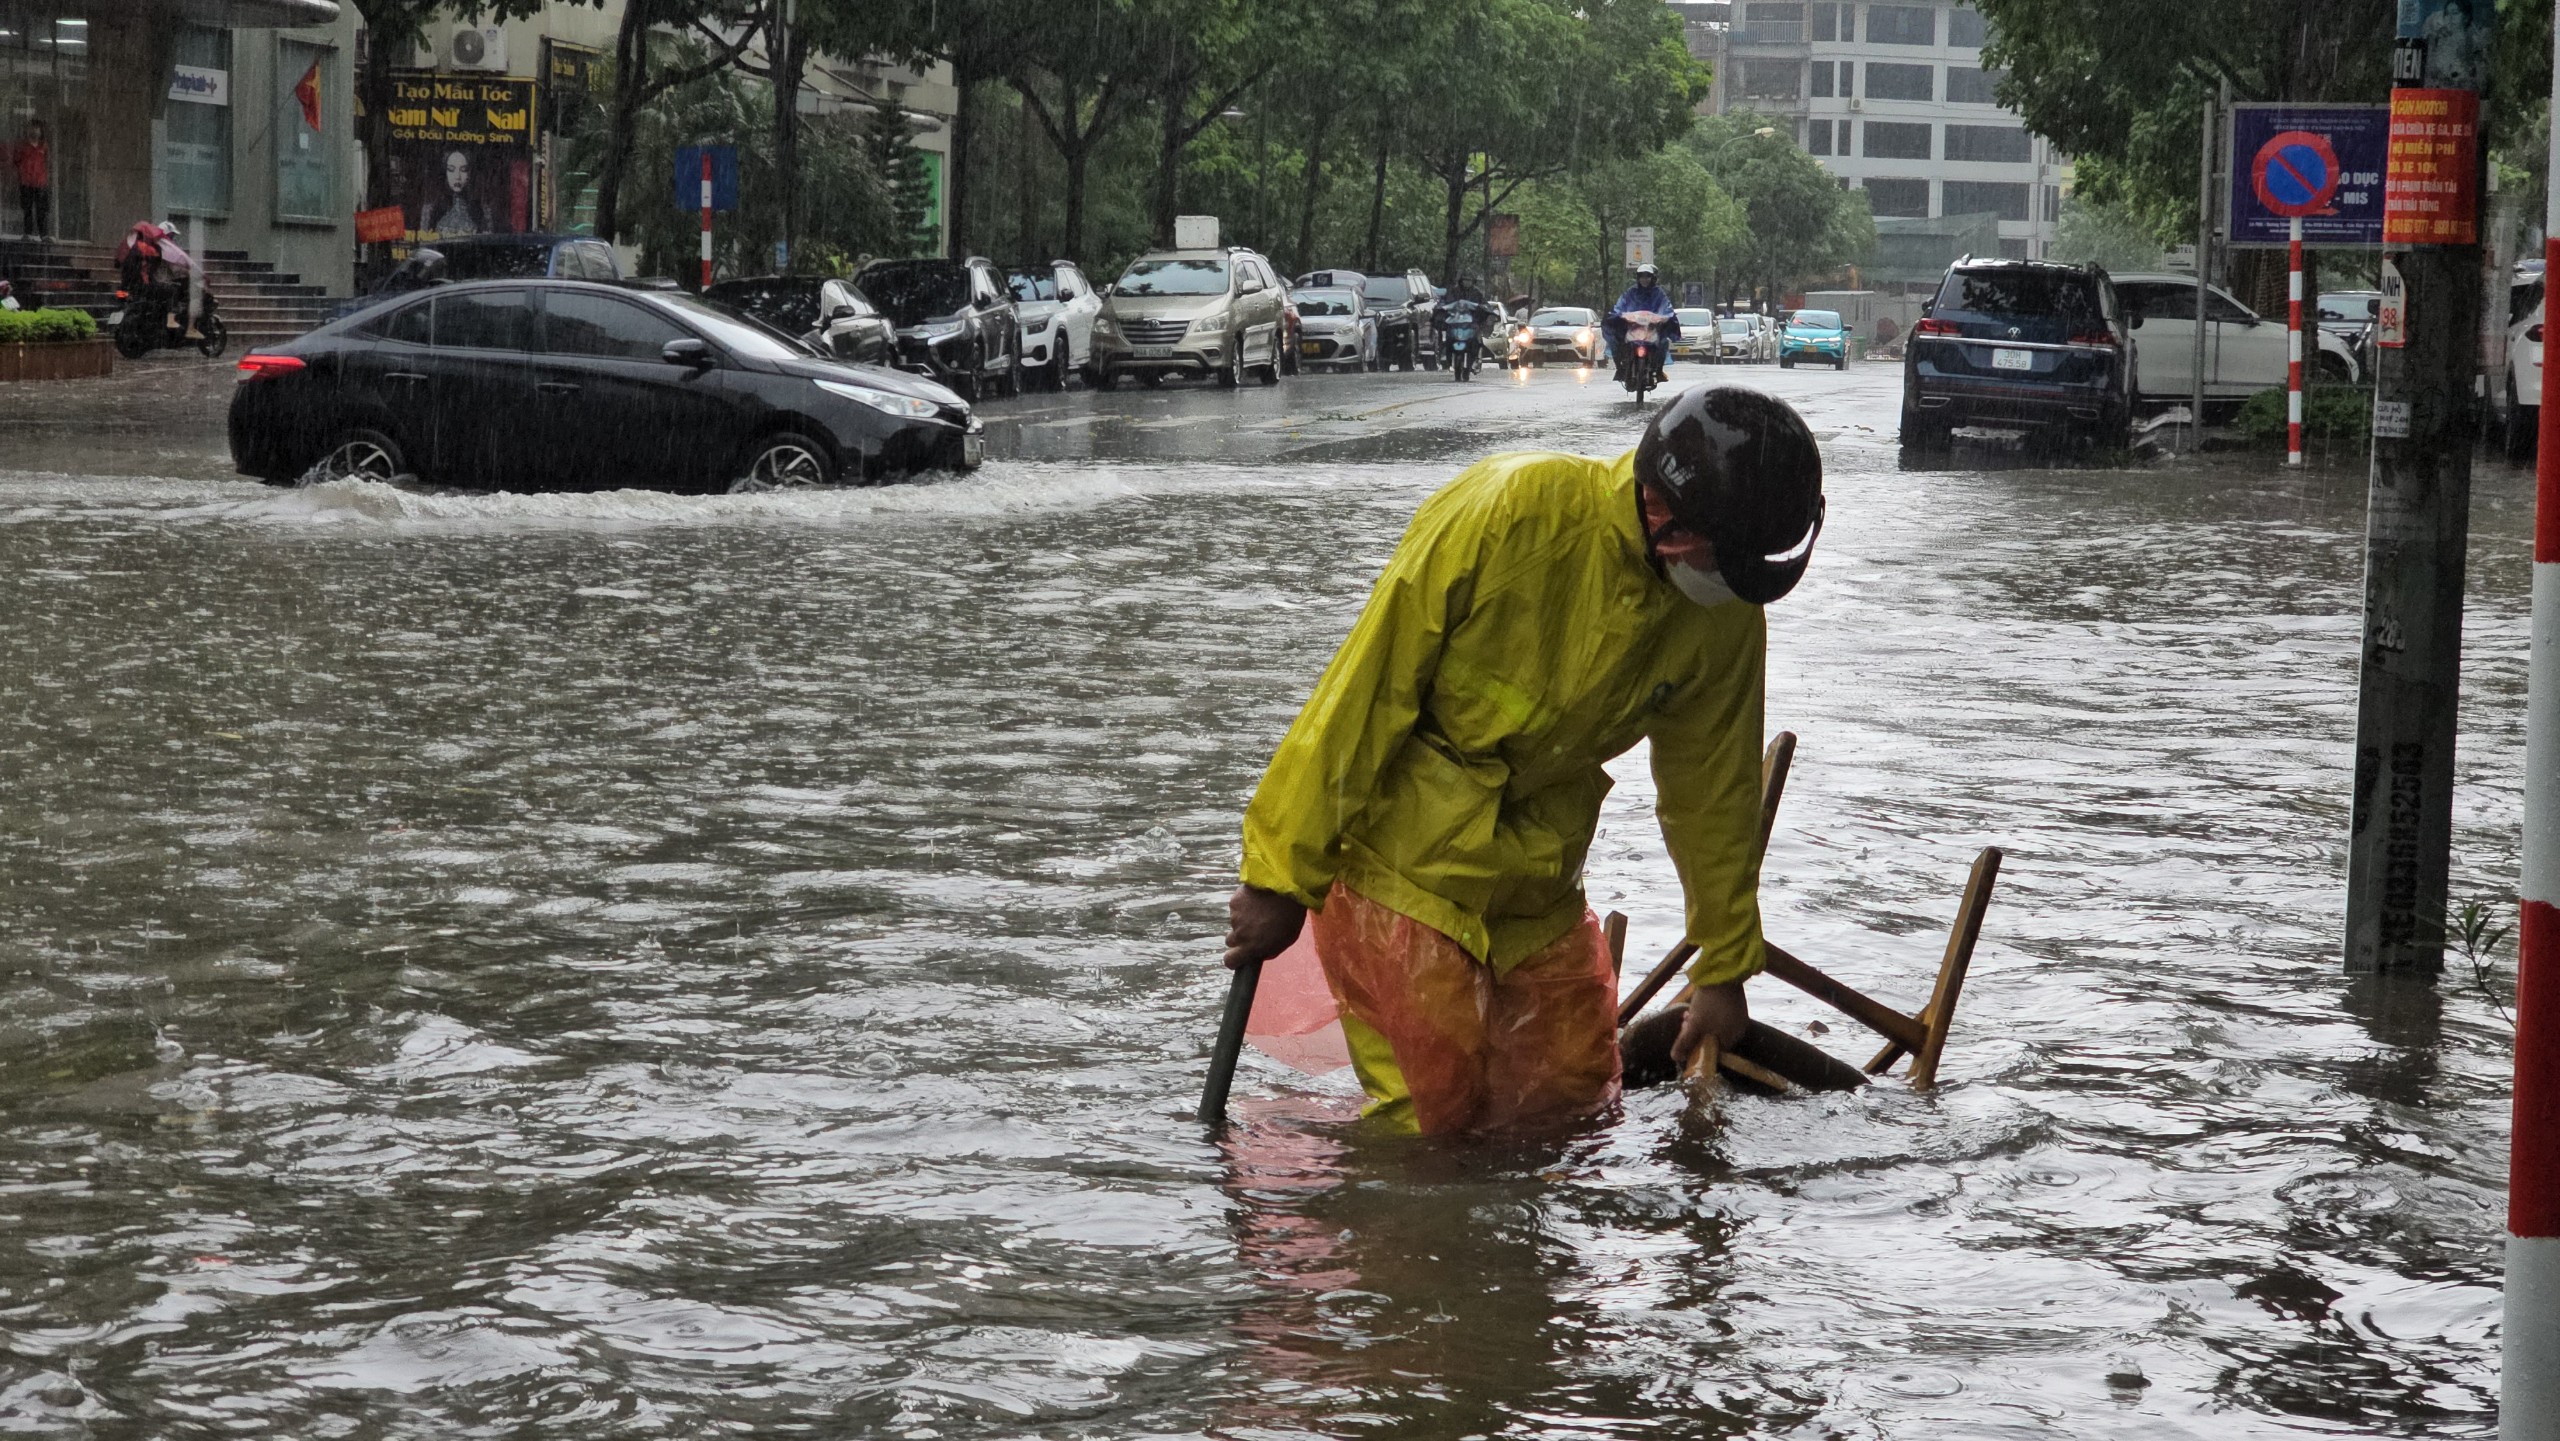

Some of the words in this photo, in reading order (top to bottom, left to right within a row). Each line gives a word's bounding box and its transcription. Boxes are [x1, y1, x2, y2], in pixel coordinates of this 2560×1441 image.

[394, 81, 431, 102] Tạo
[2414, 100, 2449, 115] MOTOR
[388, 106, 427, 126] Nam
[486, 108, 526, 130] Nail
[2425, 123, 2436, 135] XE
[2451, 124, 2462, 136] XE
[489, 131, 514, 143] Sinh
[2402, 162, 2414, 173] XE
[2353, 171, 2379, 187] DỤC
[2343, 192, 2368, 205] MIS
